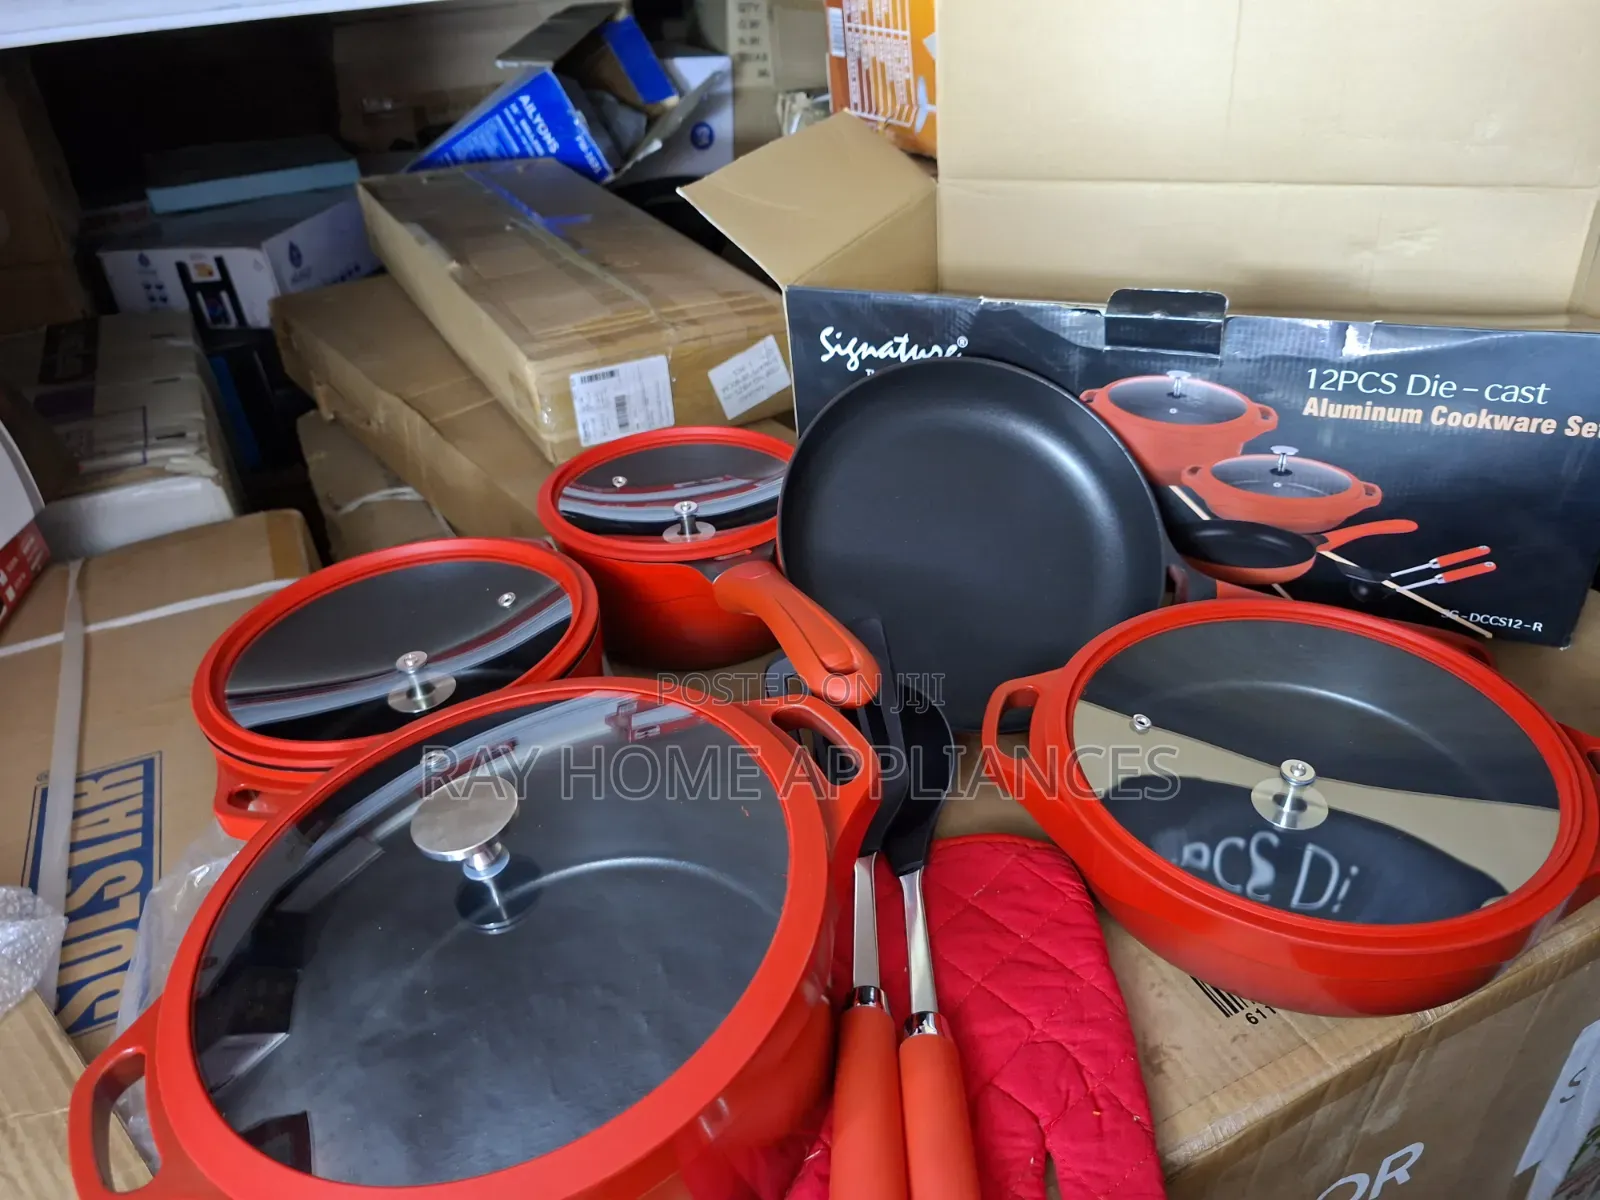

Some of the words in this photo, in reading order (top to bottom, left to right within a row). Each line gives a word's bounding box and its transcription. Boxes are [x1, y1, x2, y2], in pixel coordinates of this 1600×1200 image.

[1307, 368, 1398, 395] 12PCS
[1302, 397, 1423, 424] Aluminum
[1430, 405, 1558, 434] Cookware
